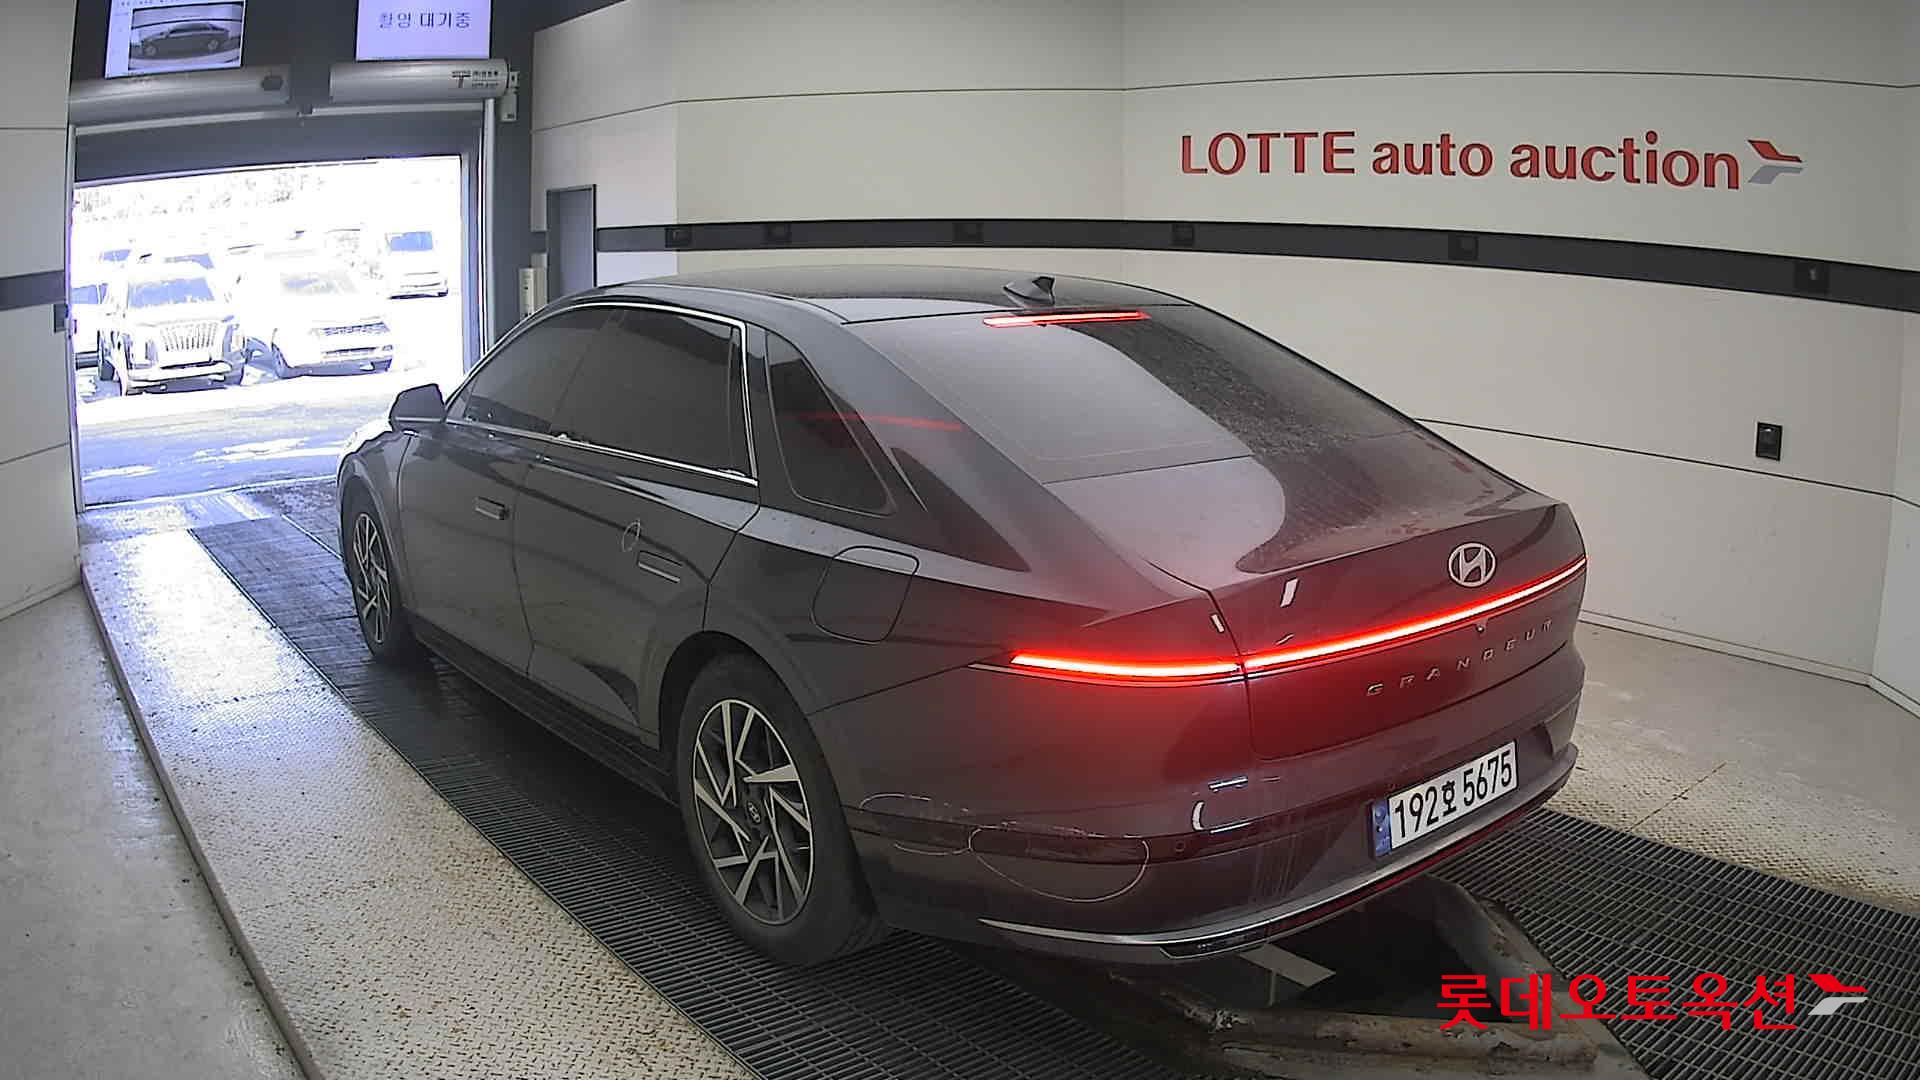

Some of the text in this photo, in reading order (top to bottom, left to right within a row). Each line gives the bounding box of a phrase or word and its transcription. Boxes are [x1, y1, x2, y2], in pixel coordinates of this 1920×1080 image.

[420, 11, 472, 29] 대기중
[1182, 130, 1739, 190] LOTTE auto auction
